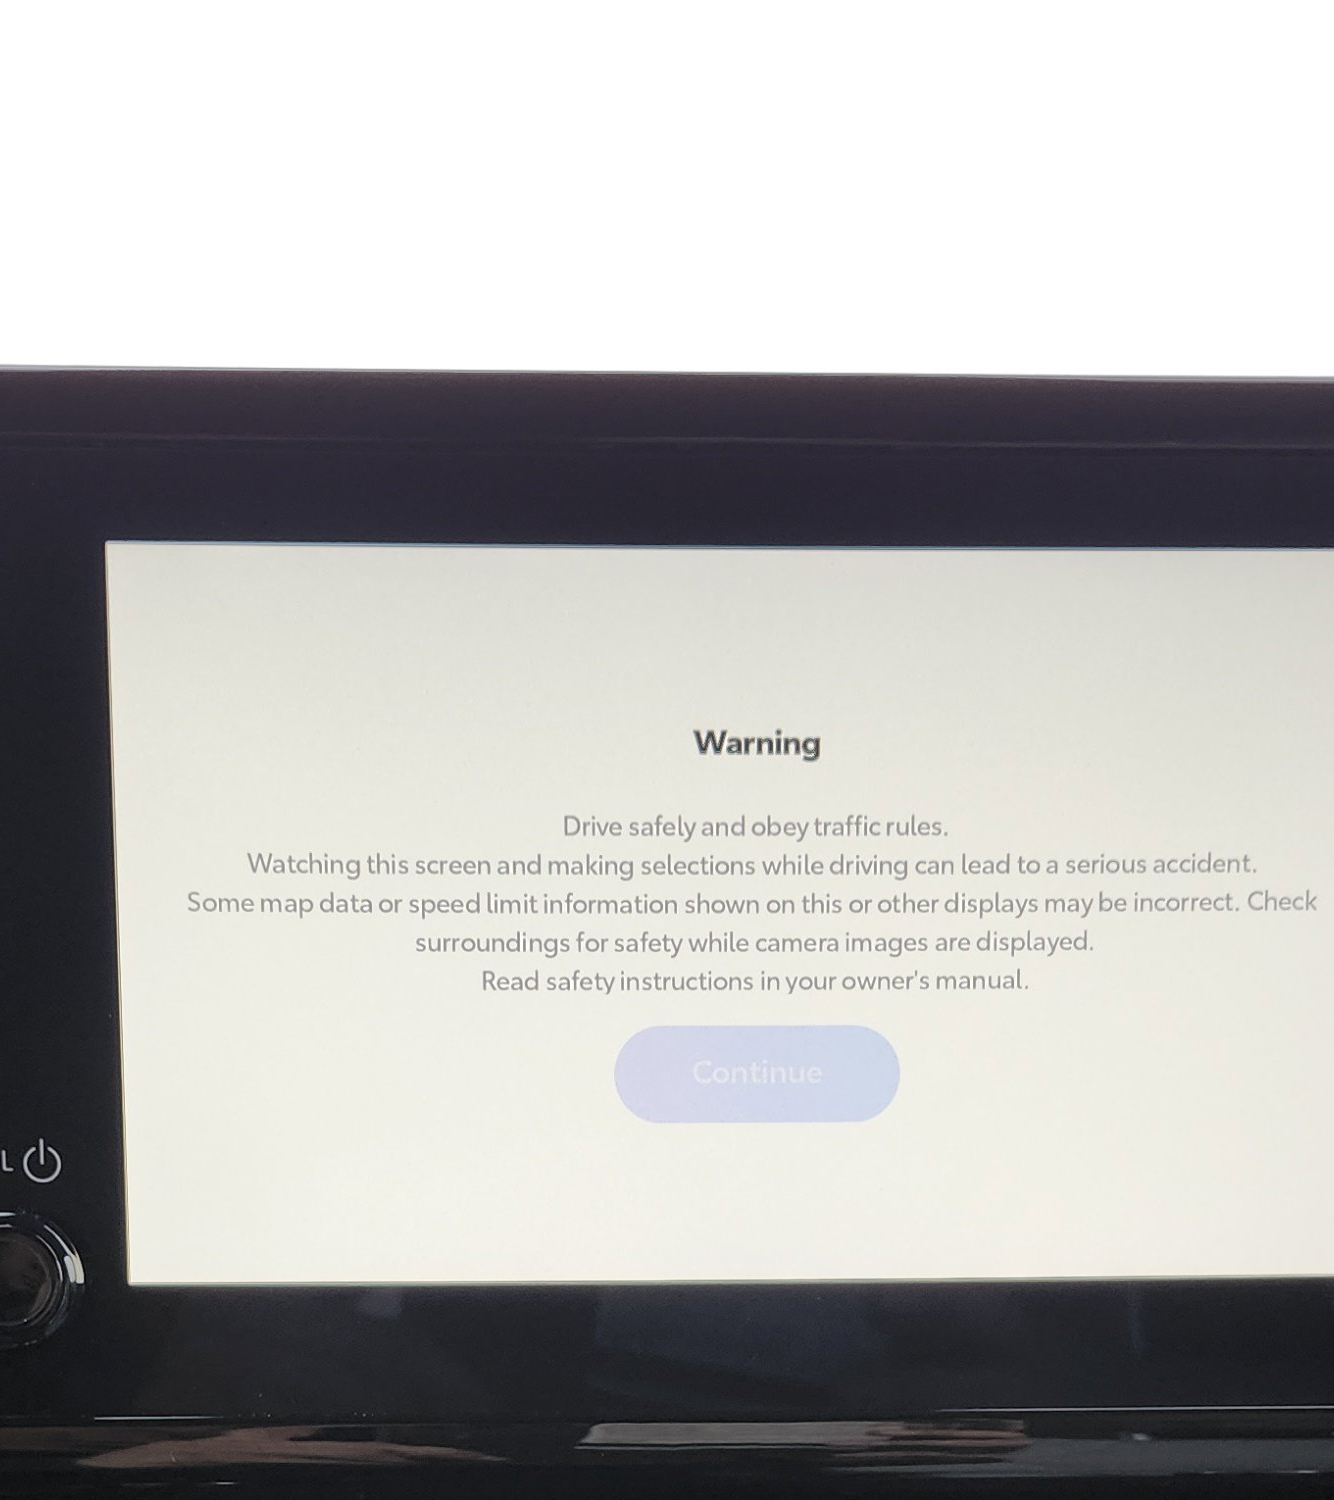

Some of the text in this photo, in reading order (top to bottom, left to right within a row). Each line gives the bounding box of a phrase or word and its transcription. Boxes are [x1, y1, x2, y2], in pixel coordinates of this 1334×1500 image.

[693, 728, 822, 762] Warning
[563, 813, 949, 843] Drive safely and obey traffic rules.
[247, 850, 1257, 882] Watching this screen and making selections while driving can lead to a serious accident.
[187, 888, 1318, 920] Some map data or speed limit information shown on this or other displays may be incorrect. Check
[415, 929, 1094, 959] surroundings for safety while camera images are displayed.
[482, 967, 1029, 996] Read safety instructions in your owner's manual.
[692, 1060, 823, 1085] Continue
